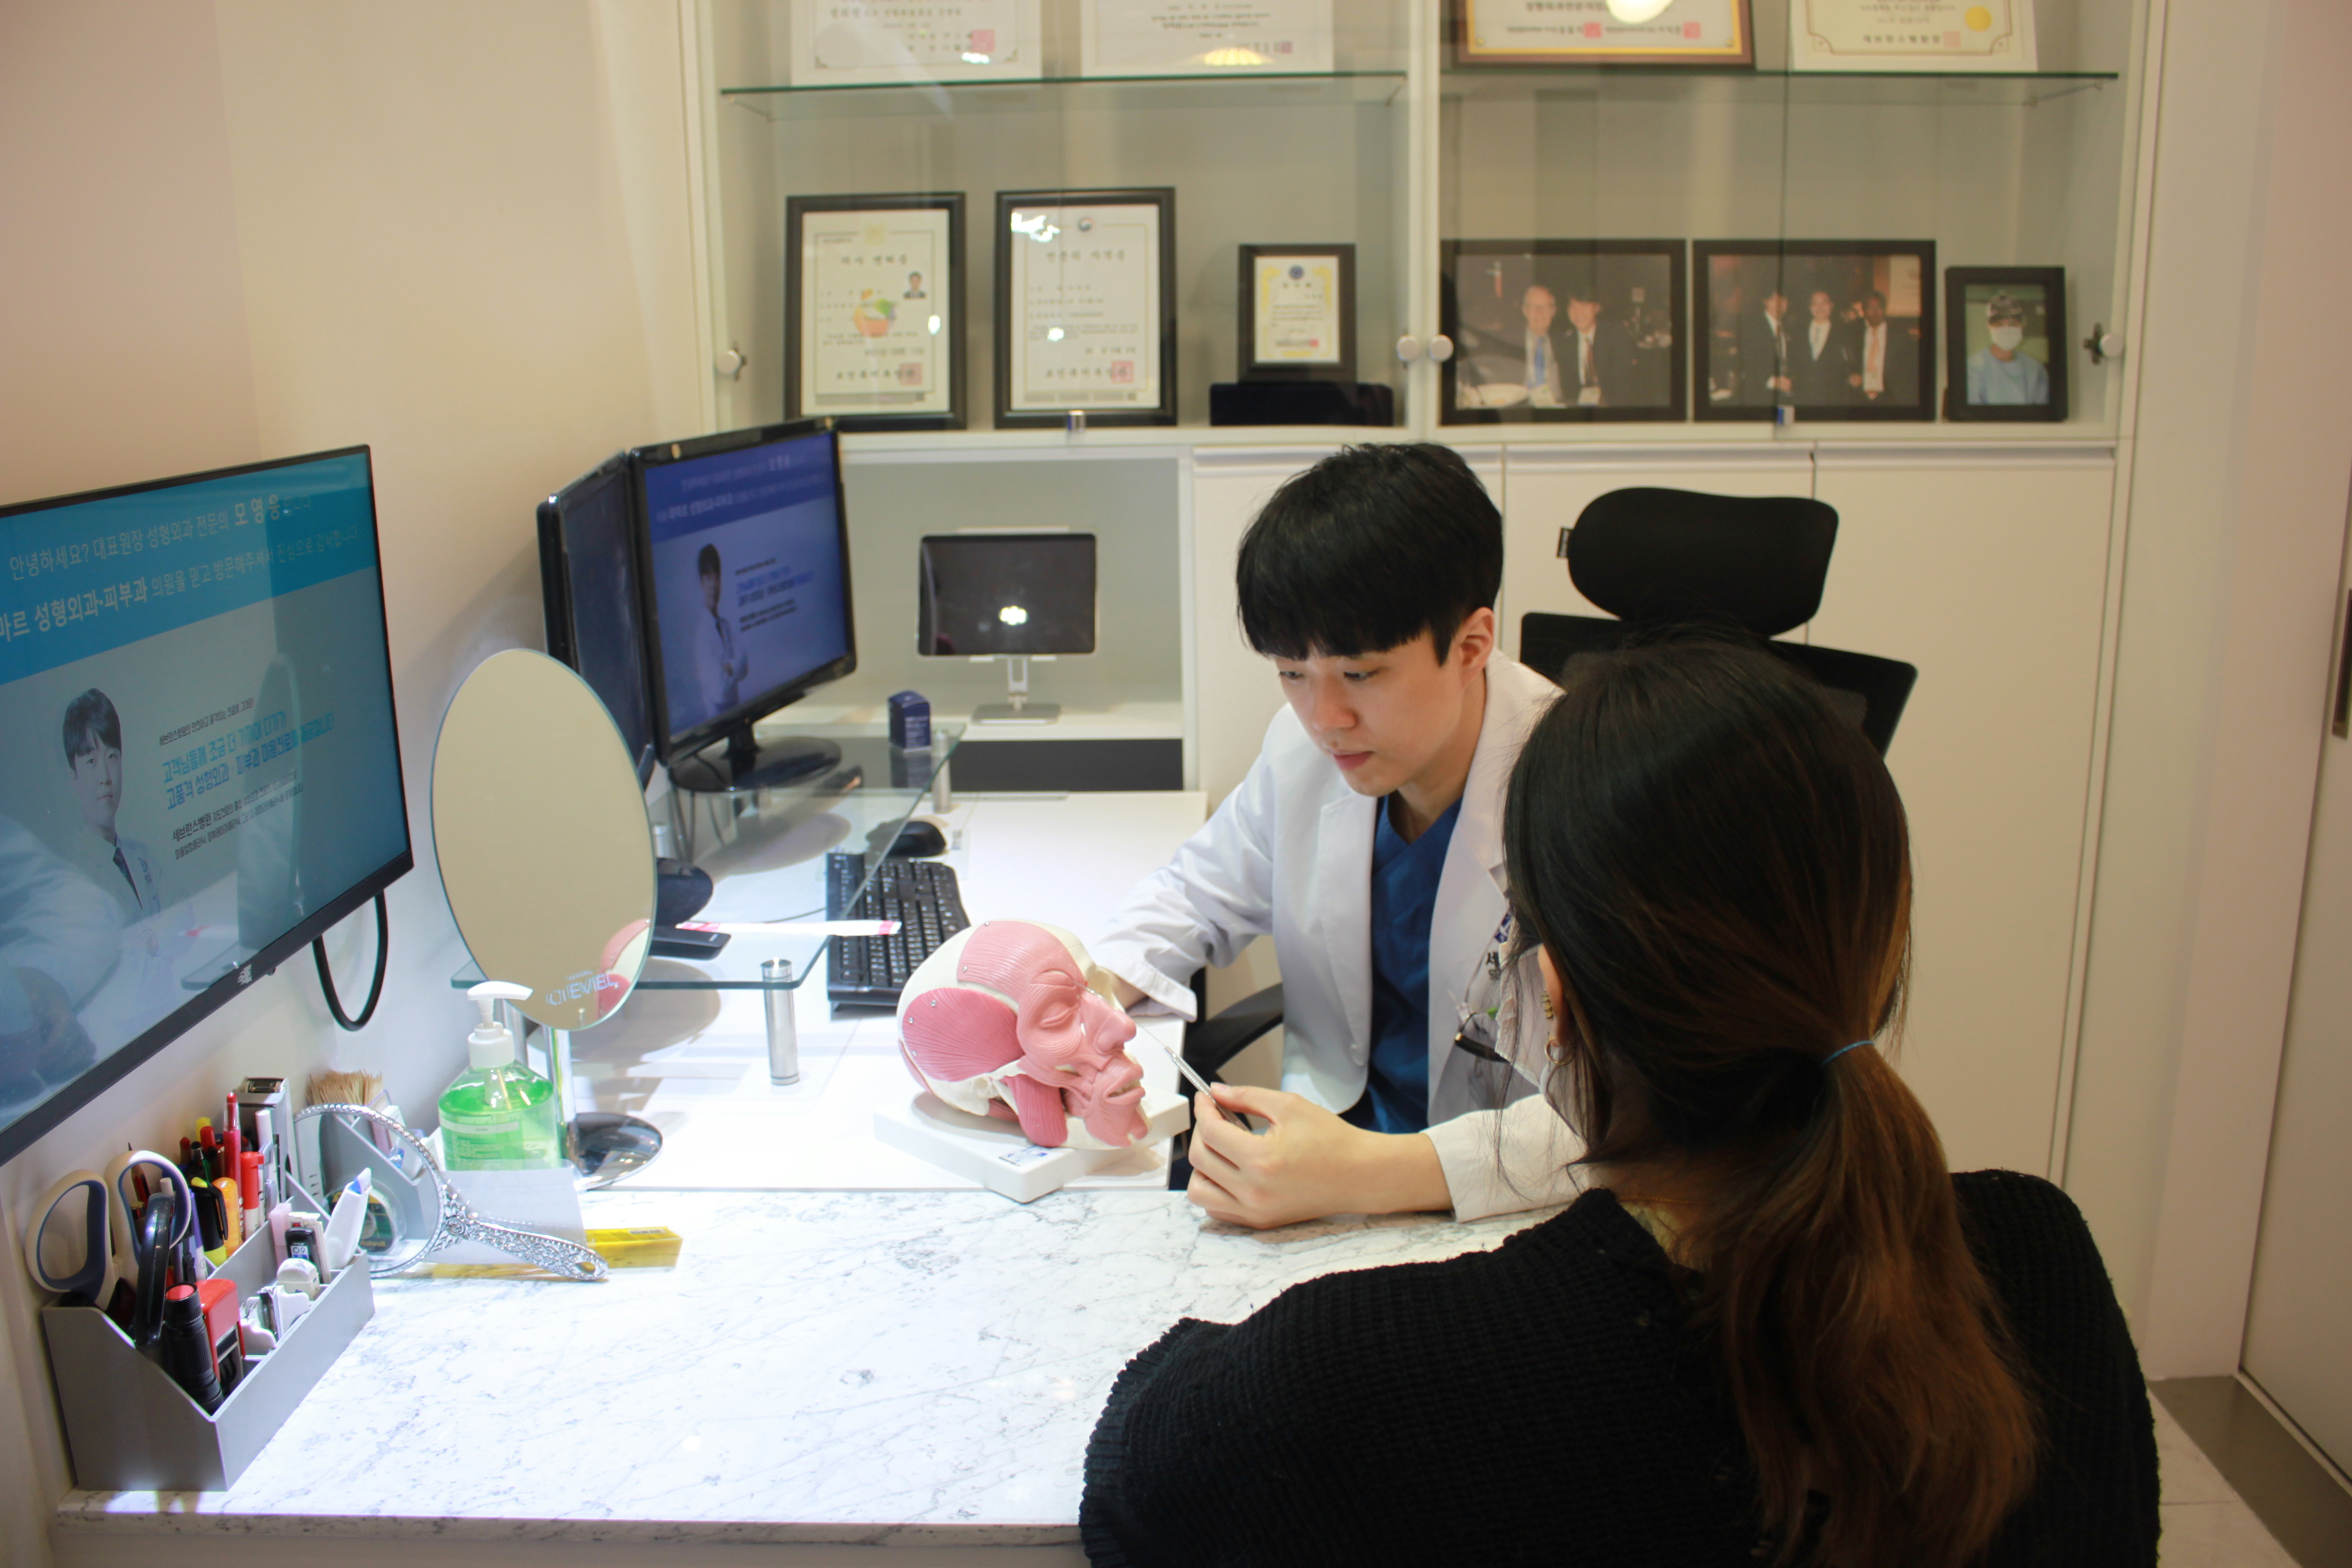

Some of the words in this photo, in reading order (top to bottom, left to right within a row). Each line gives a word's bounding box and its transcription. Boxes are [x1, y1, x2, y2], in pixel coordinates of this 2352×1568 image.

[10, 543, 89, 581] 안녕하세요?
[93, 529, 144, 560] 대표원장
[147, 518, 194, 548] 성형외과
[196, 510, 229, 537] 전문의
[151, 571, 186, 597] 의원을
[189, 565, 211, 588] 믿고
[162, 745, 207, 784] 고객님들께
[209, 737, 226, 762] 조금
[227, 733, 236, 753] 더
[166, 779, 194, 810] 고품격
[196, 762, 230, 795] 성형외과
[236, 747, 260, 775] 피부과
[173, 812, 212, 842] 세브란스병원
